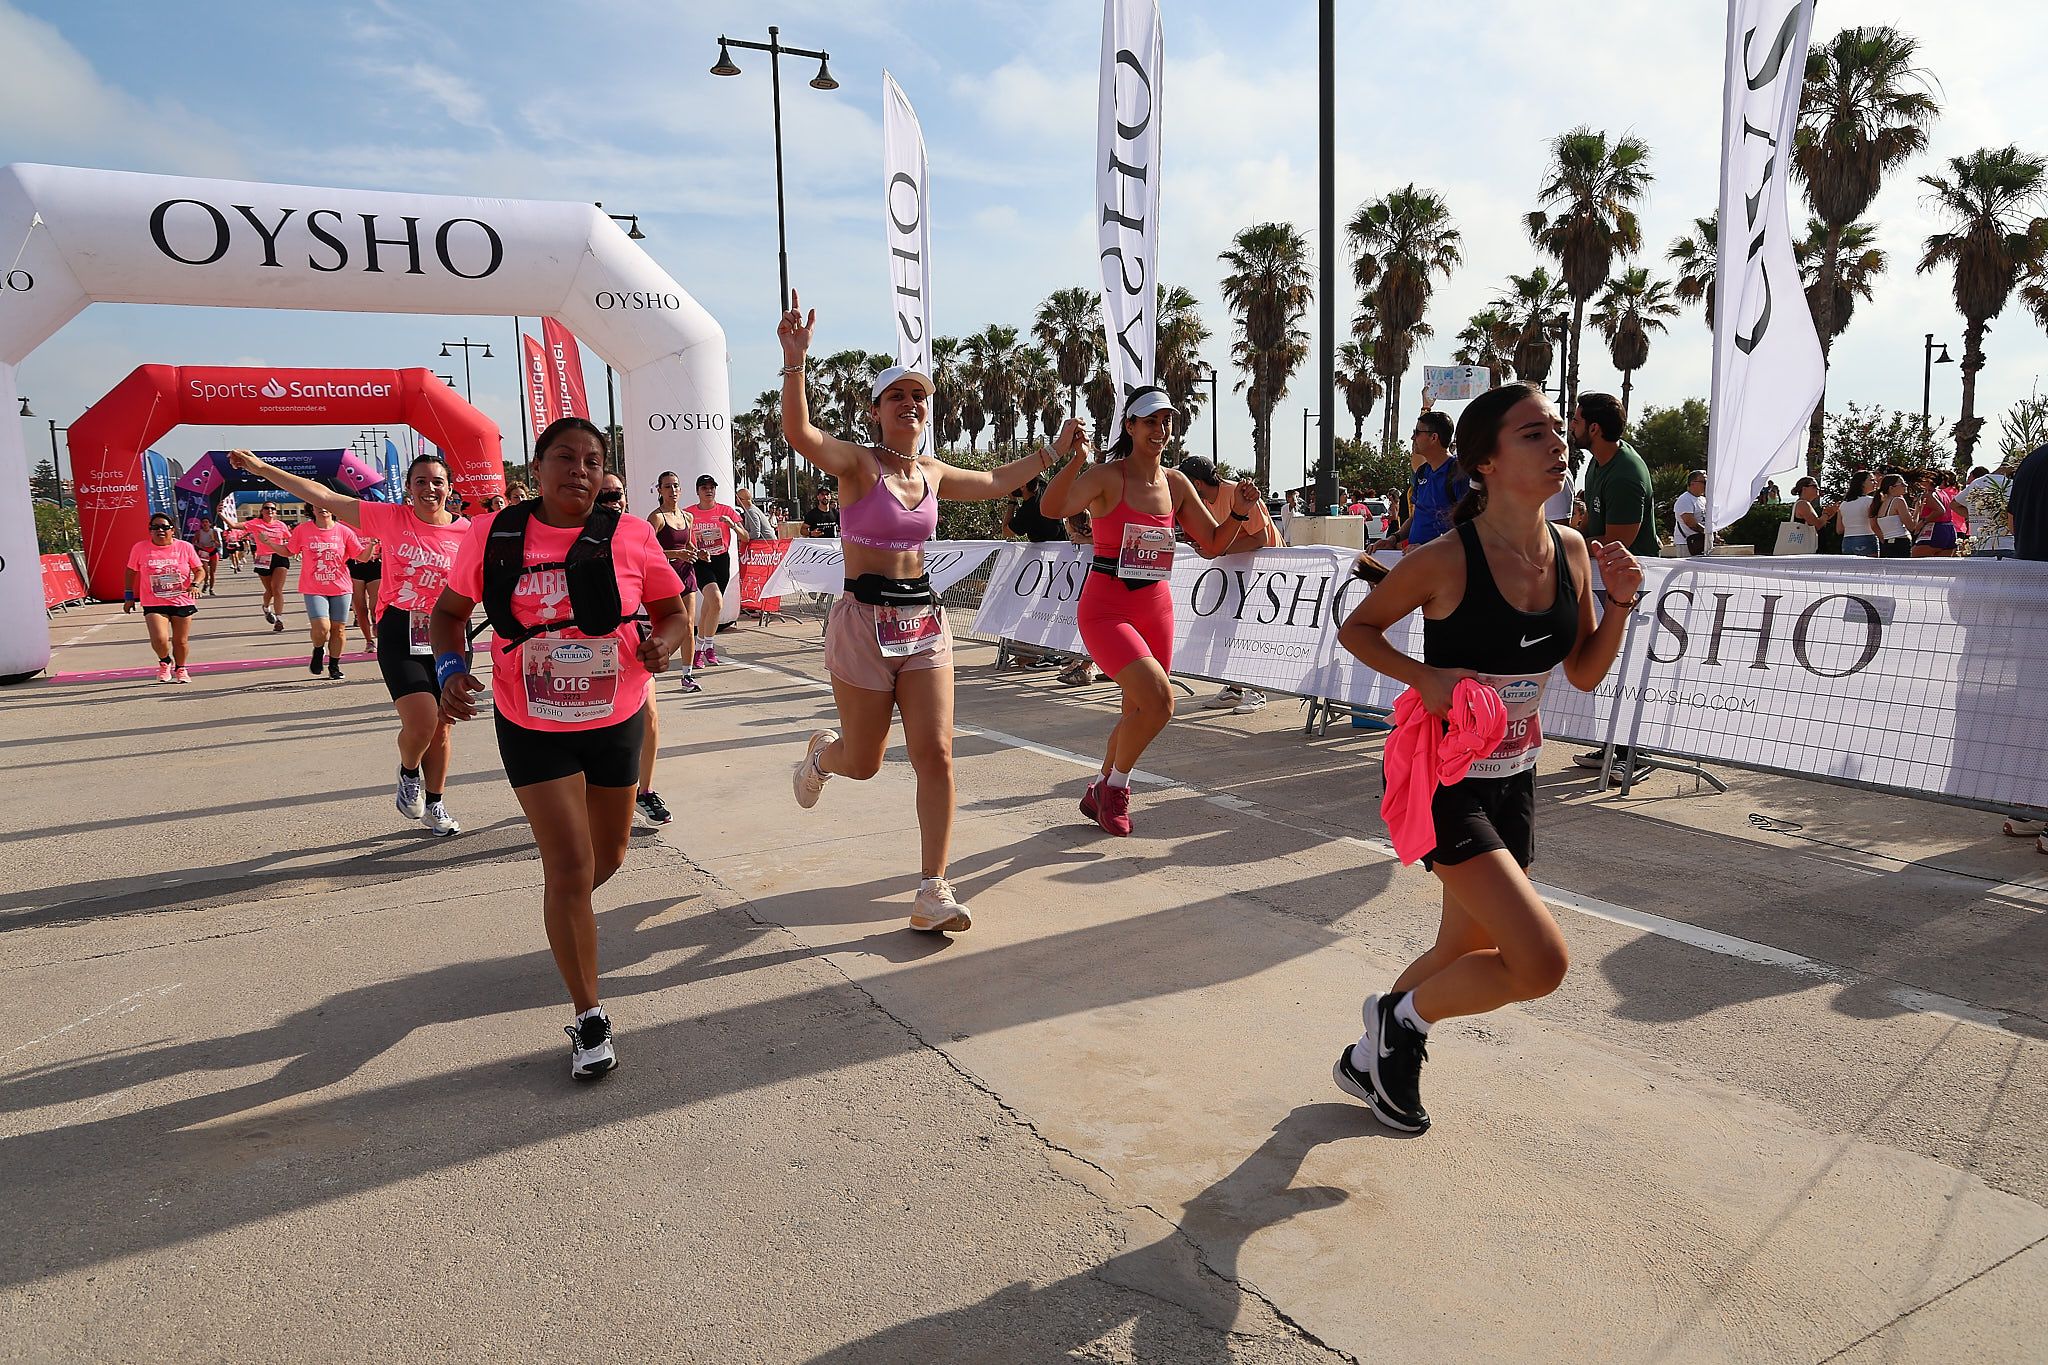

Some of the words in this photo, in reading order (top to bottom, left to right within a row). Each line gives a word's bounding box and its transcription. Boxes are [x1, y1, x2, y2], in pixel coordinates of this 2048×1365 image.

[149, 198, 504, 279] OYSHO
[595, 291, 680, 310] OYSHO
[190, 380, 258, 401] Sports
[289, 381, 391, 398] Santander
[259, 405, 326, 413] sportssantander.es
[648, 413, 724, 431] OYSHO
[465, 460, 492, 470] Sports
[90, 470, 124, 481] Sports
[464, 473, 503, 482] Santander
[89, 483, 139, 493] Santander
[850, 535, 872, 545] NIKE
[889, 541, 909, 549] NIKE
[397, 543, 452, 569] CARRERA
[525, 552, 552, 560] SHO
[749, 550, 782, 566] Santander
[1137, 549, 1159, 560] 016
[418, 569, 439, 590] DE
[514, 571, 569, 596] CARR
[1014, 559, 1093, 602] OYS
[1191, 567, 1371, 630] OYSHO
[899, 619, 921, 631] 016
[1592, 590, 1883, 679] SHO
[1224, 636, 1311, 659] WWW.OYSHO.COM
[554, 651, 591, 660] ASTURIANA
[553, 677, 590, 691] 016
[536, 707, 563, 717] OYSHO
